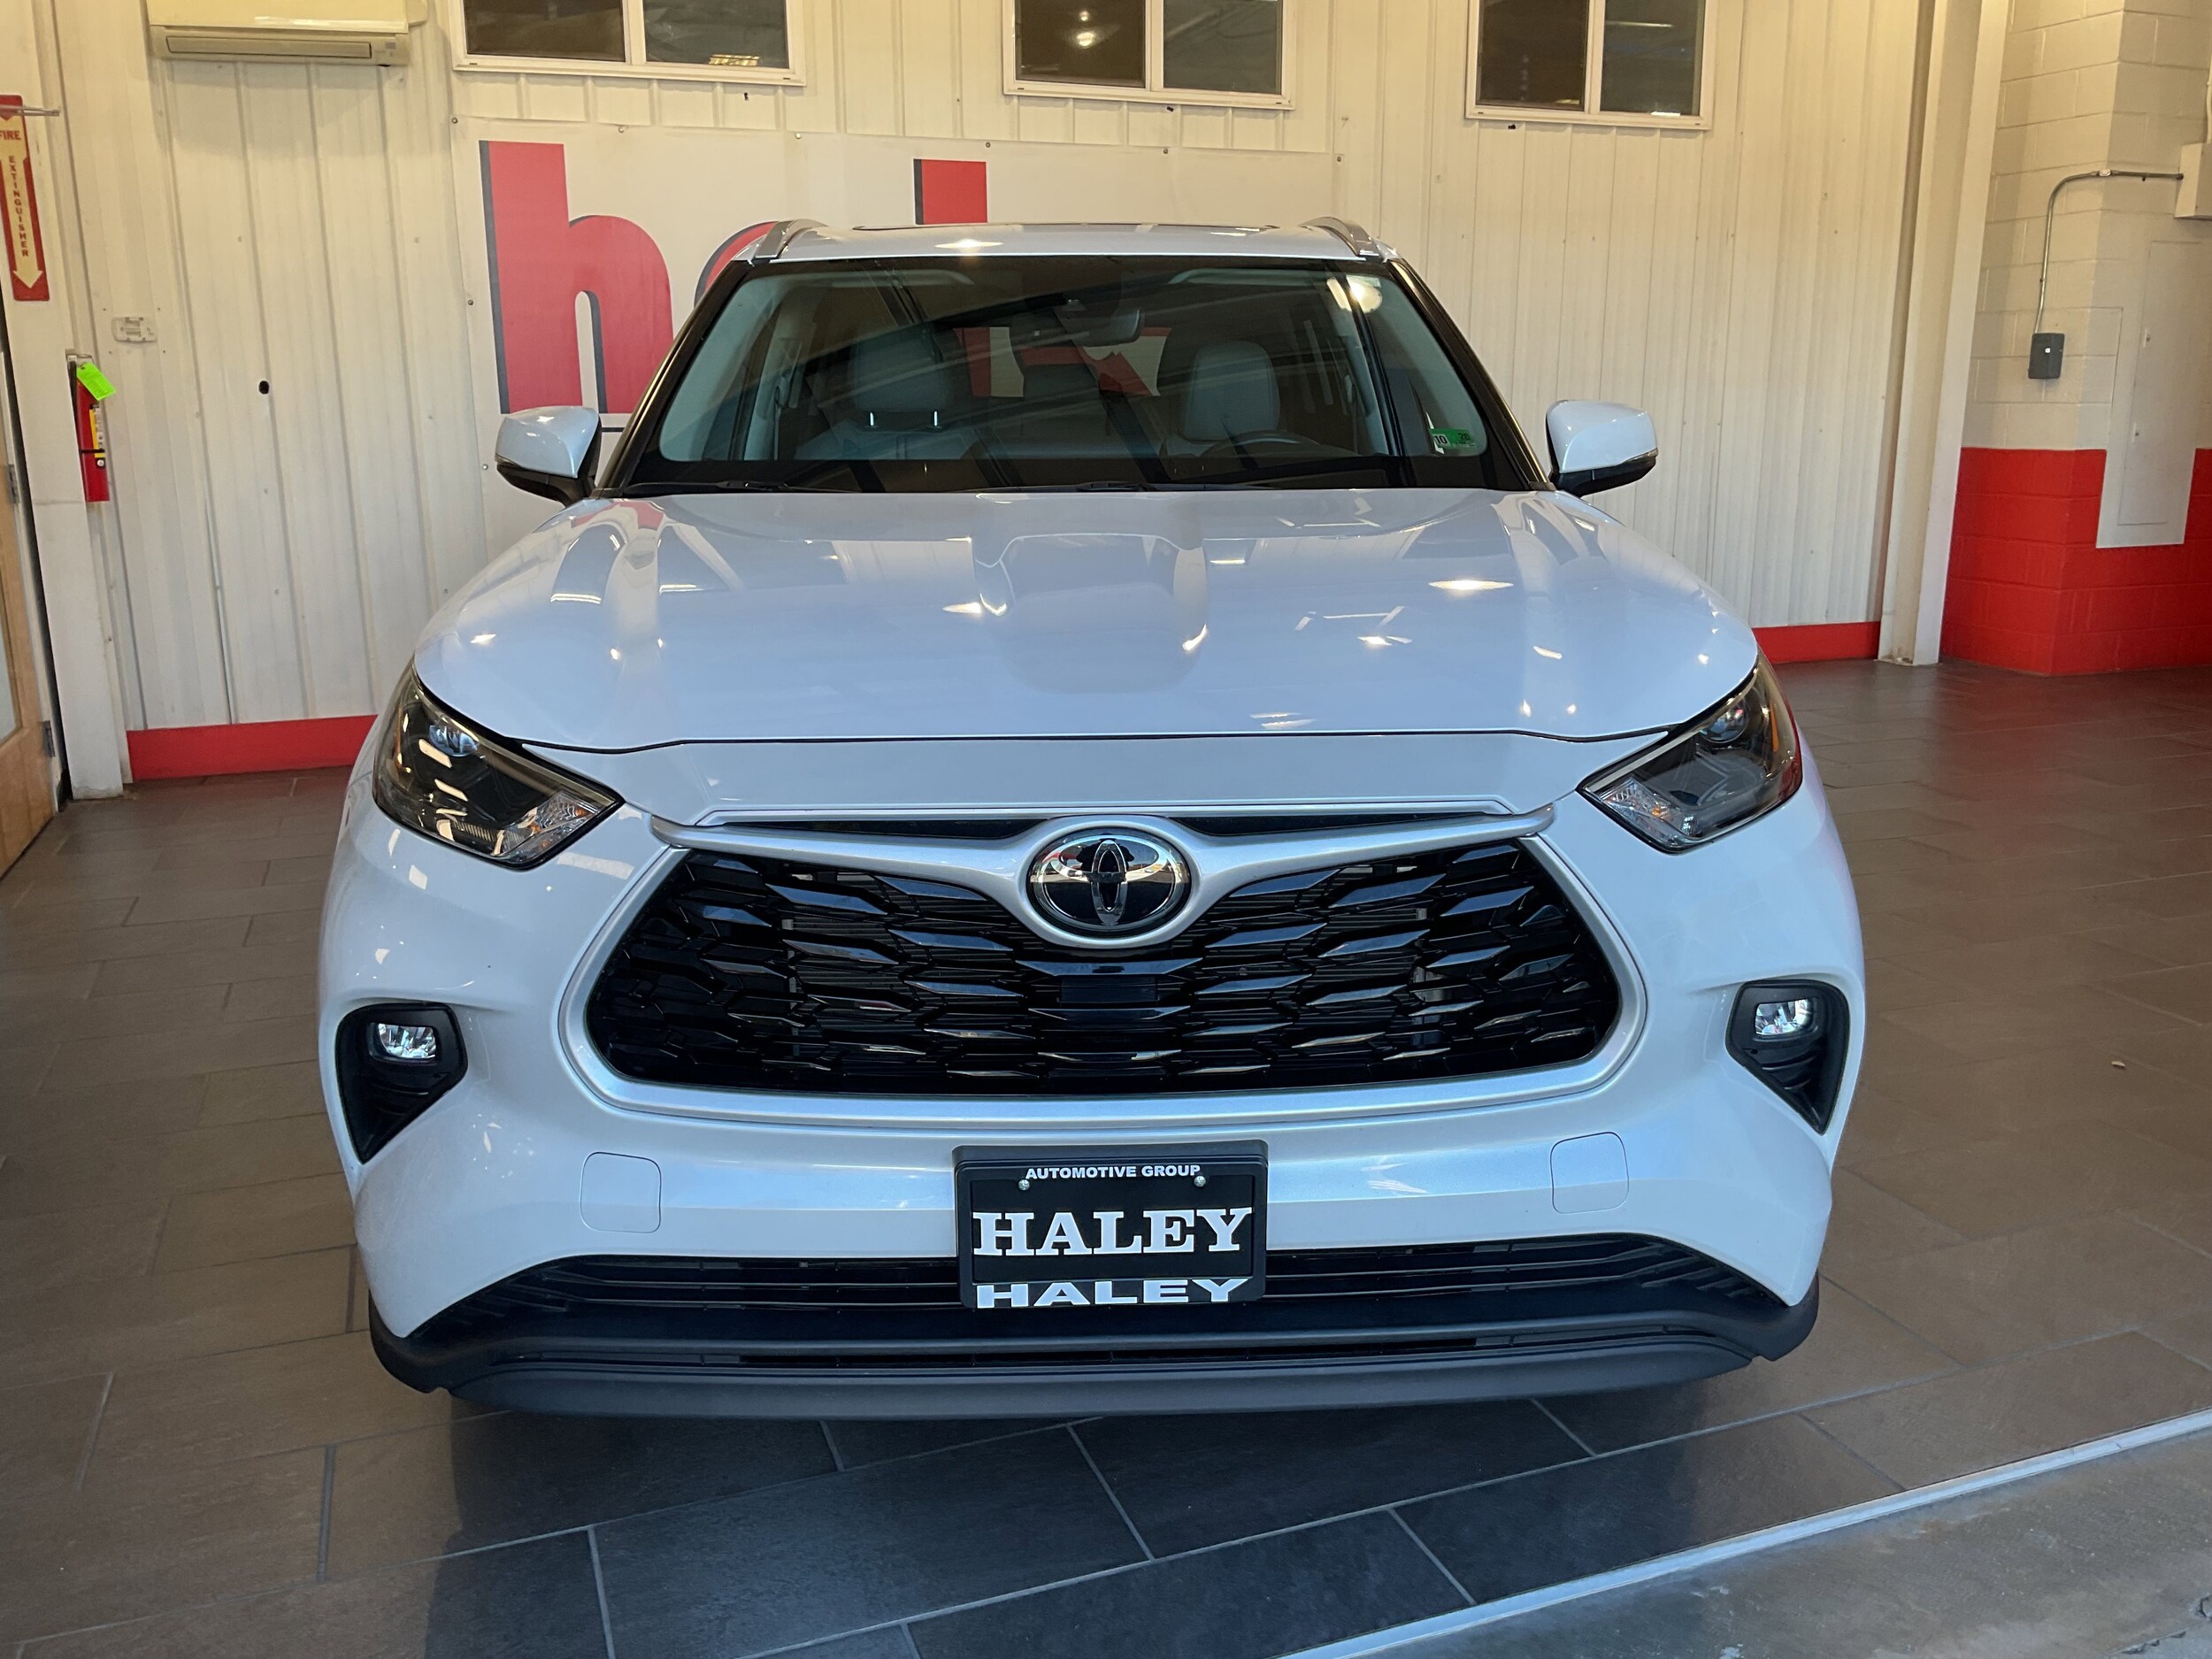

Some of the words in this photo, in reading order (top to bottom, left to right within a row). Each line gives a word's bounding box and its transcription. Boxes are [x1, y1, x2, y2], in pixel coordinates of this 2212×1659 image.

[8, 156, 29, 257] EXTINGUISHER
[1025, 1166, 1137, 1179] AUTOMOTIVE
[1141, 1164, 1201, 1177] GROUP
[972, 1207, 1253, 1256] HALEY
[977, 1279, 1248, 1309] HALEY
